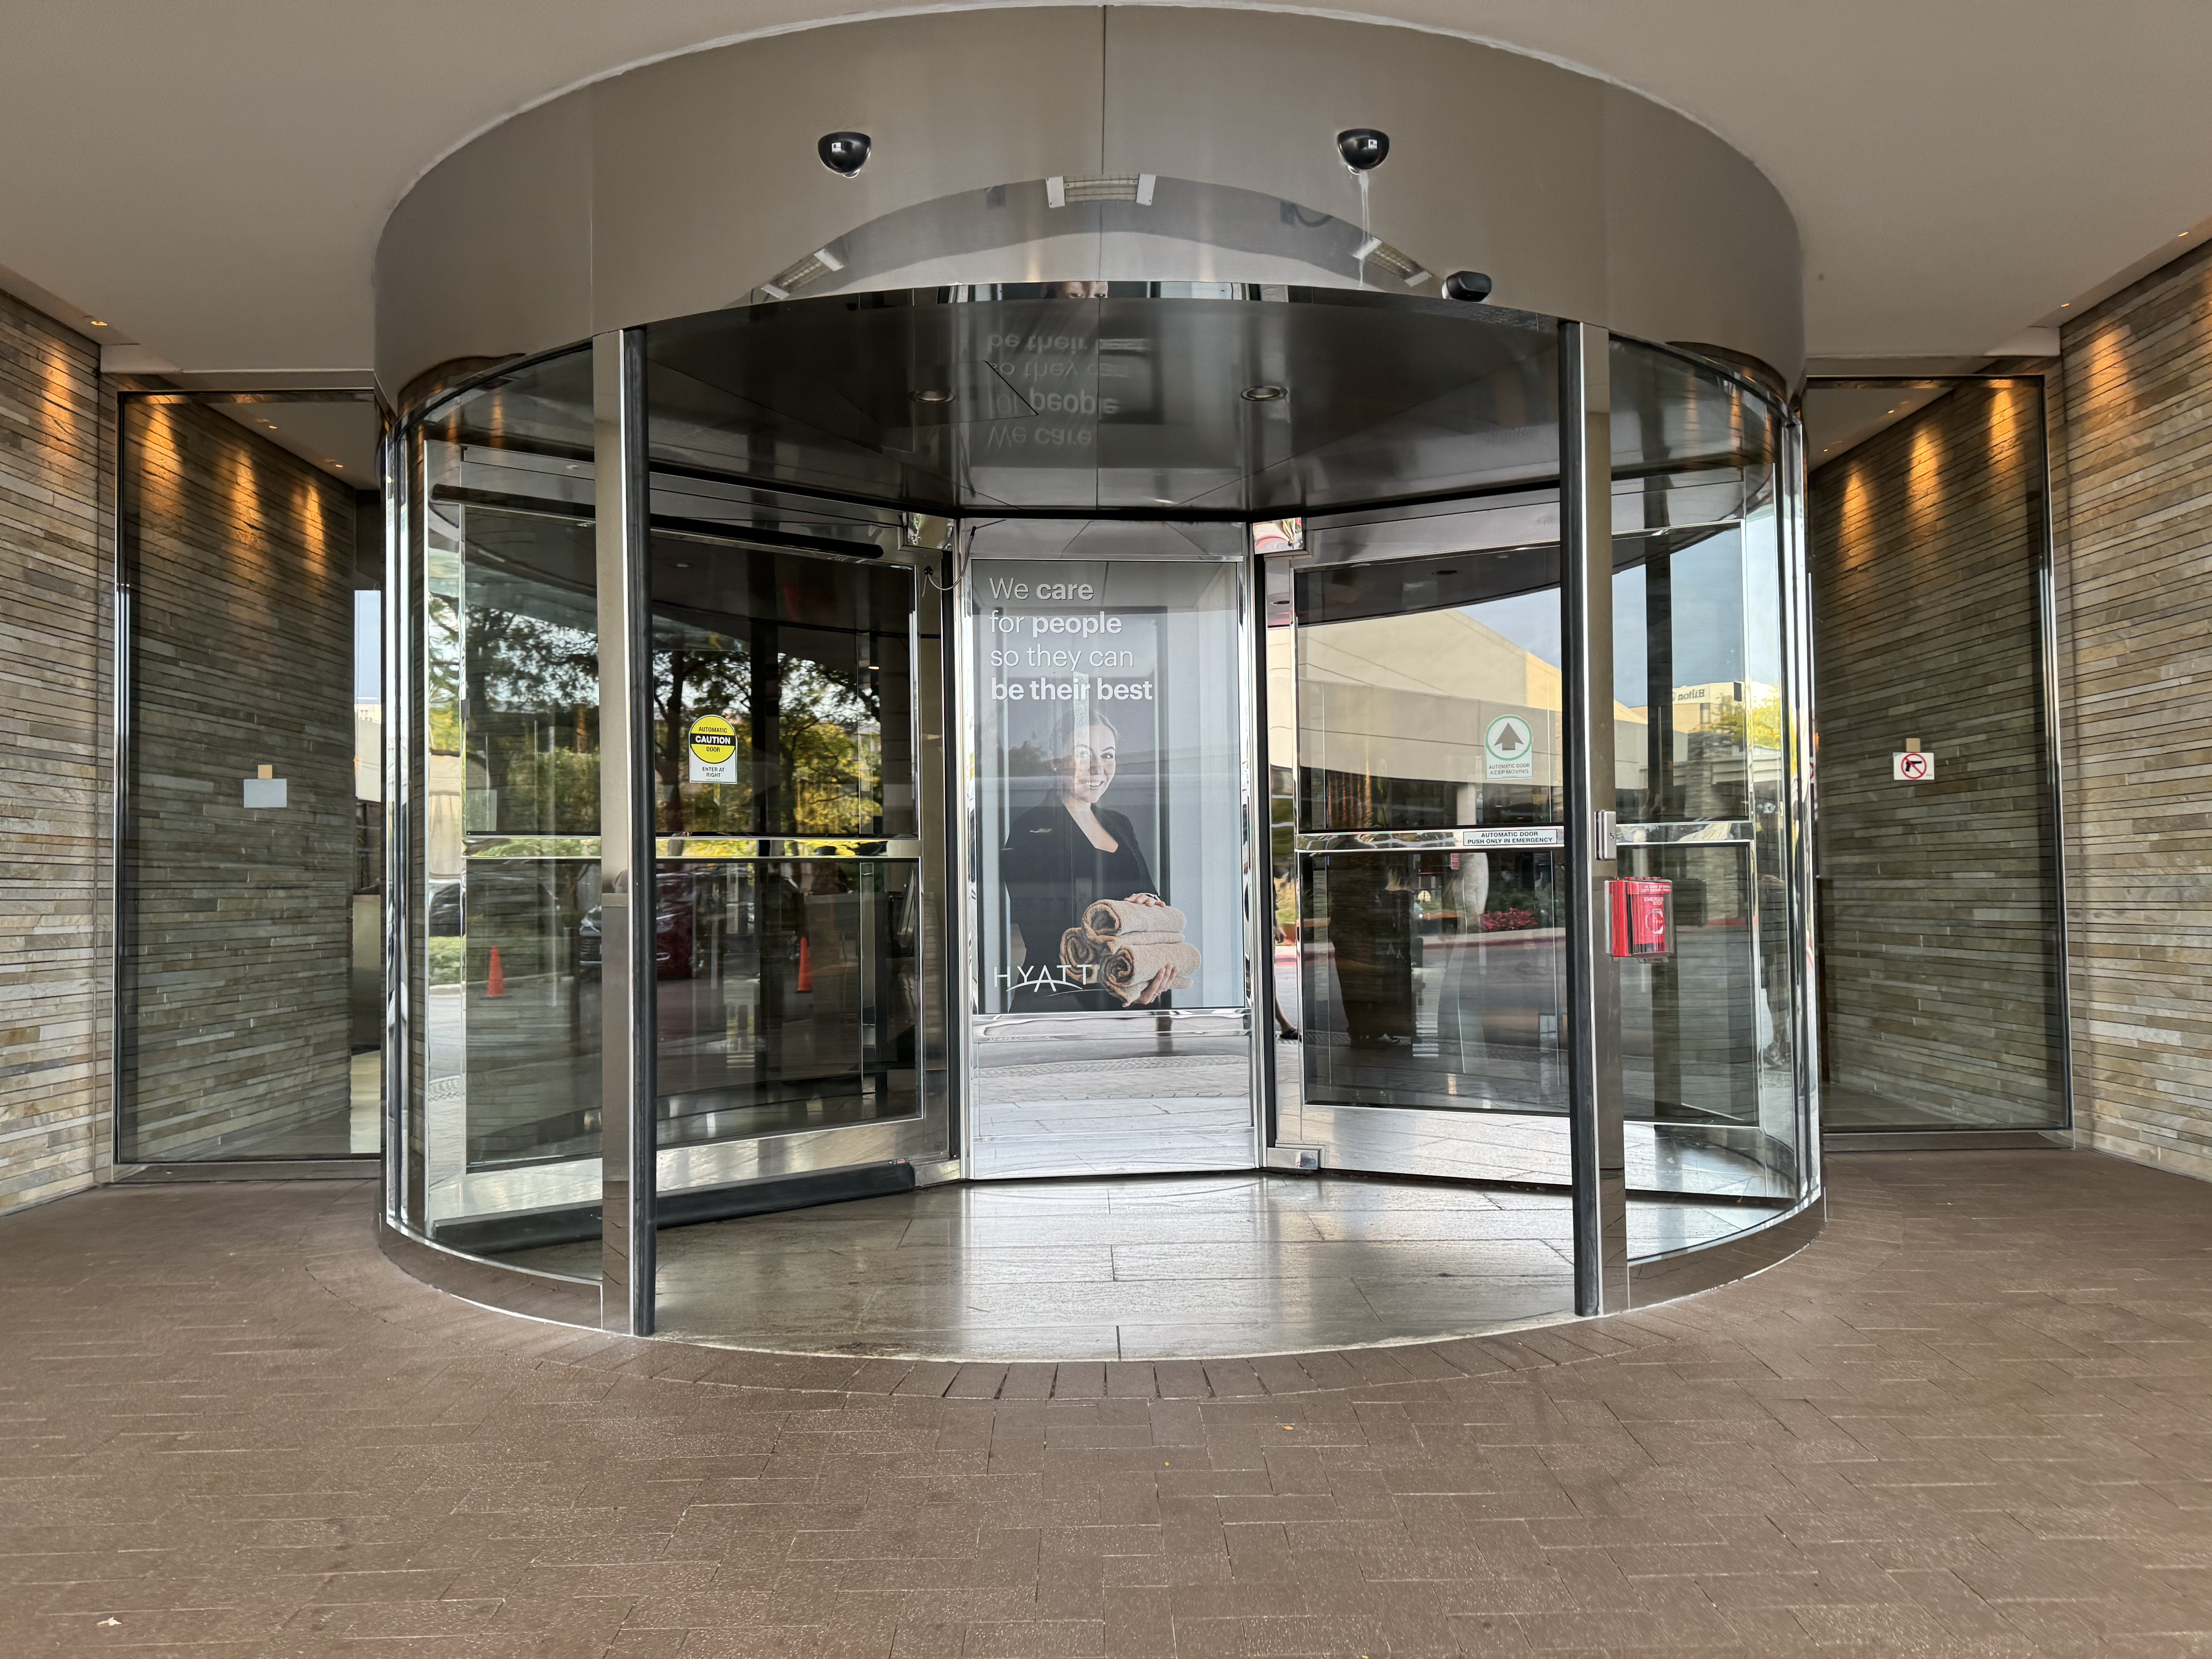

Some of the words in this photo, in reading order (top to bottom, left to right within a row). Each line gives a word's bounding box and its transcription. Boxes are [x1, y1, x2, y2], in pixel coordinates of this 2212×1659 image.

[989, 577, 1029, 600] We
[1036, 582, 1094, 600] care
[989, 610, 1024, 634] for
[1032, 611, 1122, 638] people
[990, 650, 1019, 667] so
[1027, 644, 1082, 672] they
[1089, 650, 1134, 667] can
[991, 677, 1024, 700] be
[1030, 677, 1090, 700] their
[1097, 677, 1153, 700] best
[695, 735, 731, 744] CAUTION
[994, 963, 1092, 992] HYATT
